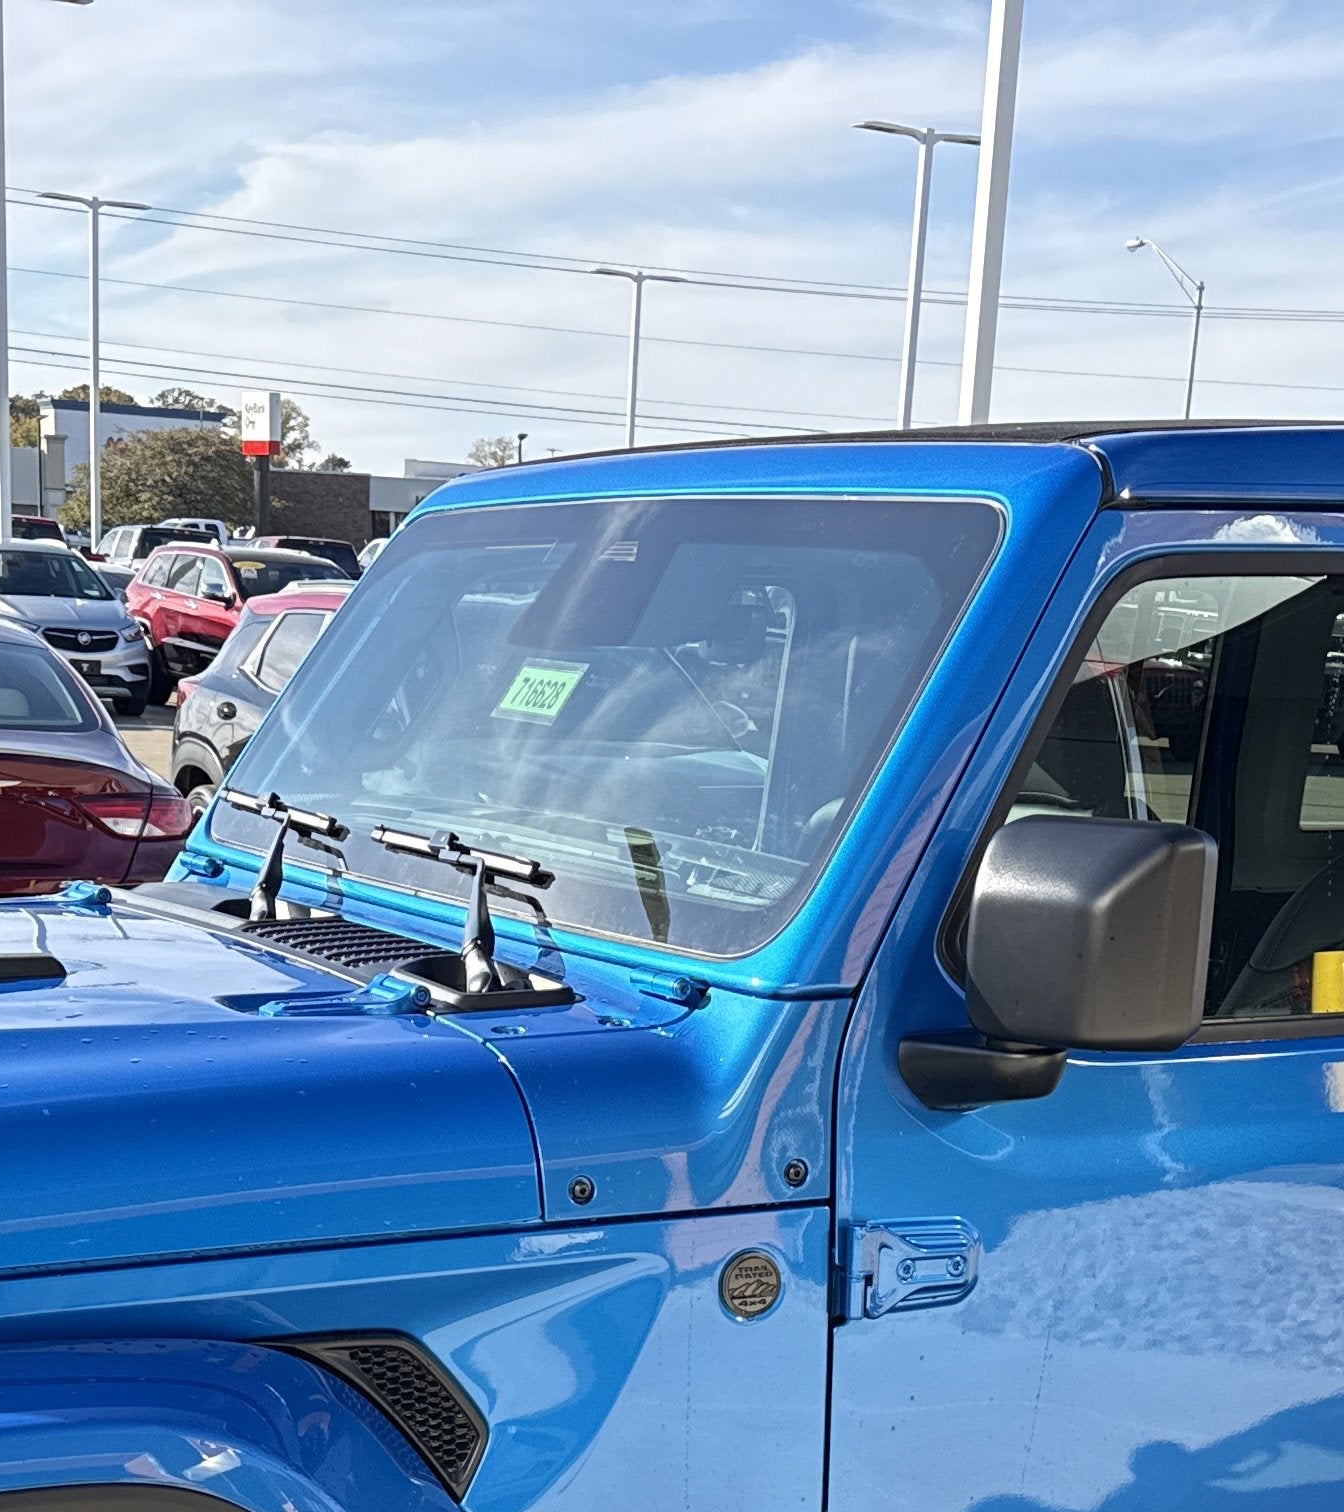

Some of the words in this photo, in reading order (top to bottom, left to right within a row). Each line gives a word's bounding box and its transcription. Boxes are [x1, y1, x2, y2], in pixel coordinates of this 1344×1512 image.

[510, 677, 567, 709] 716628
[737, 1265, 770, 1273] TRAIL
[735, 1271, 773, 1280] RATED
